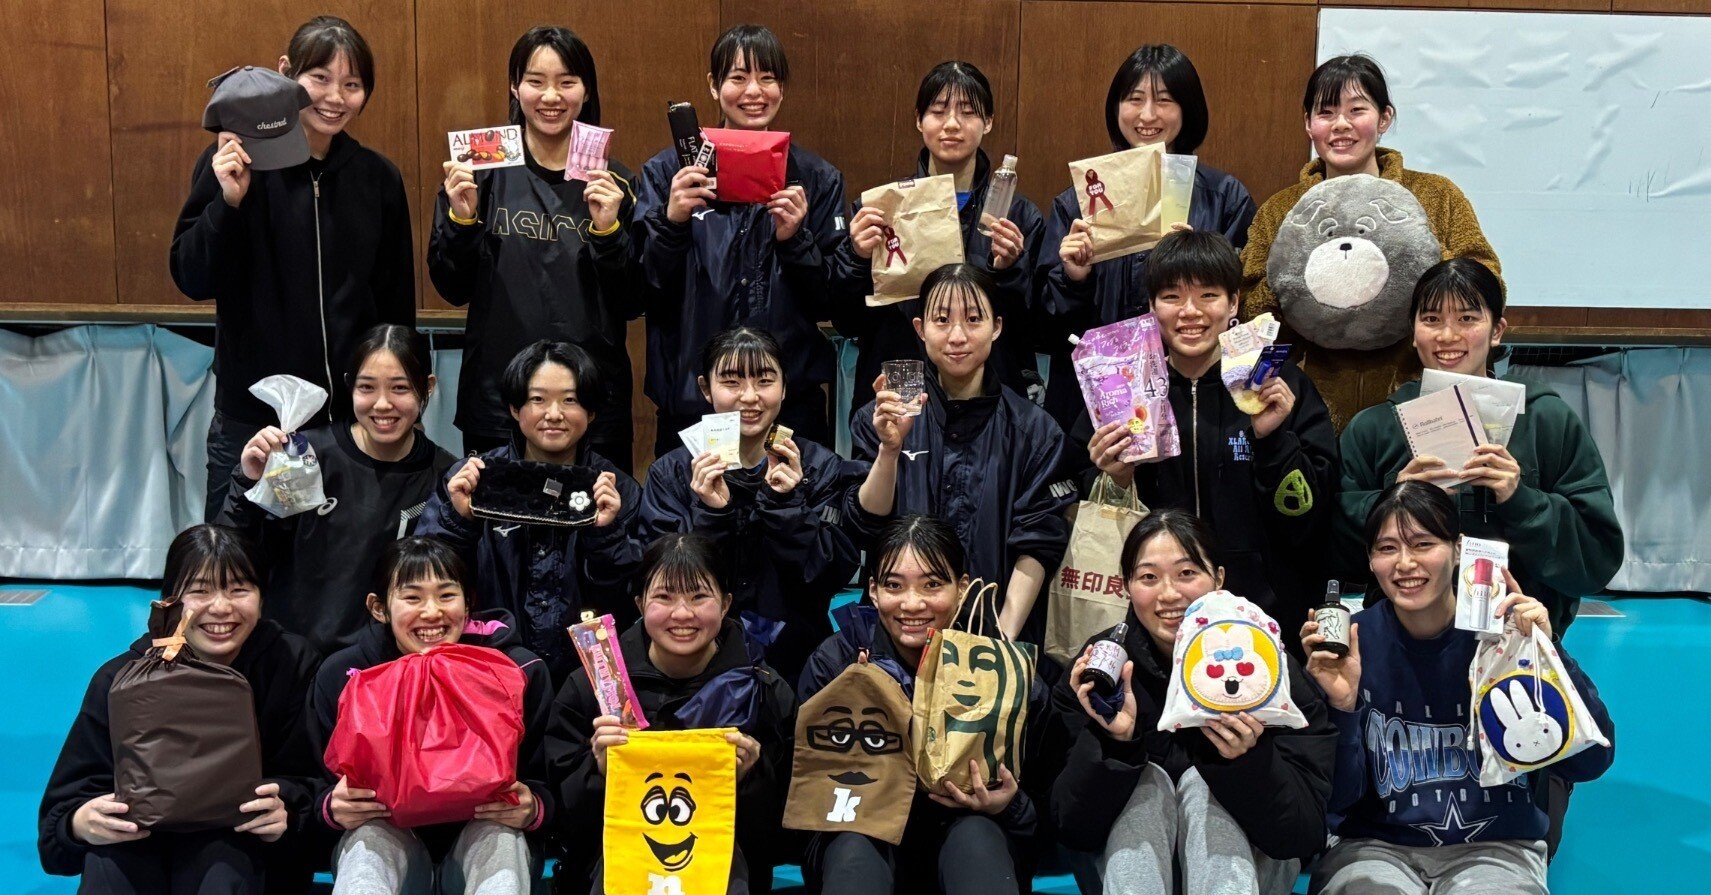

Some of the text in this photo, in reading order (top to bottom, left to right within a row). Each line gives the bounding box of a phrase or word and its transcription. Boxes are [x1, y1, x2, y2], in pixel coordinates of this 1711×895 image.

[687, 135, 699, 155] FLAT
[1100, 386, 1128, 400] Aroma
[1101, 397, 1119, 409] Rich
[1061, 565, 1130, 600] 無印良
[826, 786, 862, 822] k
